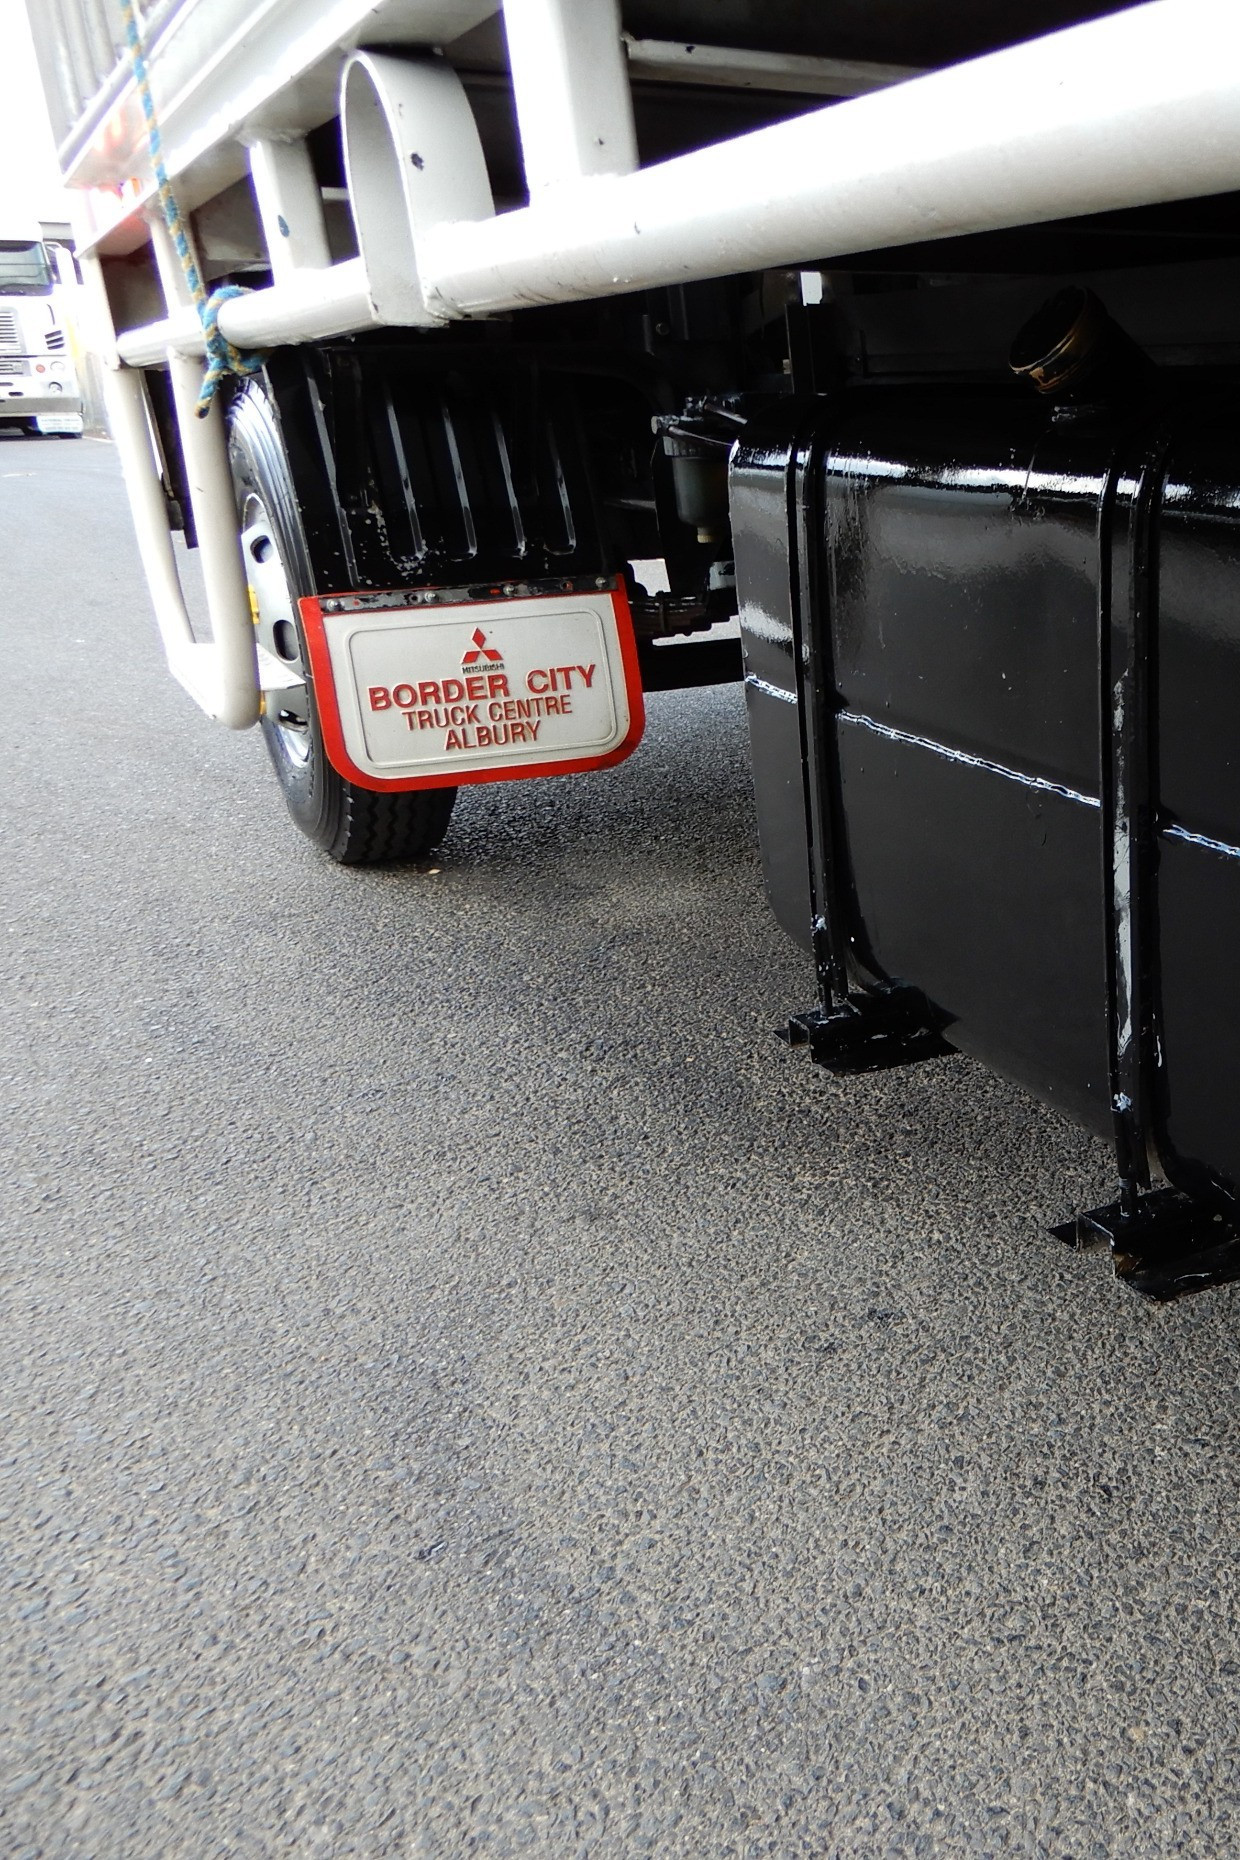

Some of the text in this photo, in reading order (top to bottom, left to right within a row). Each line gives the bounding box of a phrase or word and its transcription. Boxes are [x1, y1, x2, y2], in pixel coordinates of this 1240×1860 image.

[462, 663, 505, 674] MITSUBISHI
[367, 664, 597, 711] BORDER CITY
[402, 694, 573, 731] TRUCK CENTRE
[444, 720, 541, 751] ALBURY
